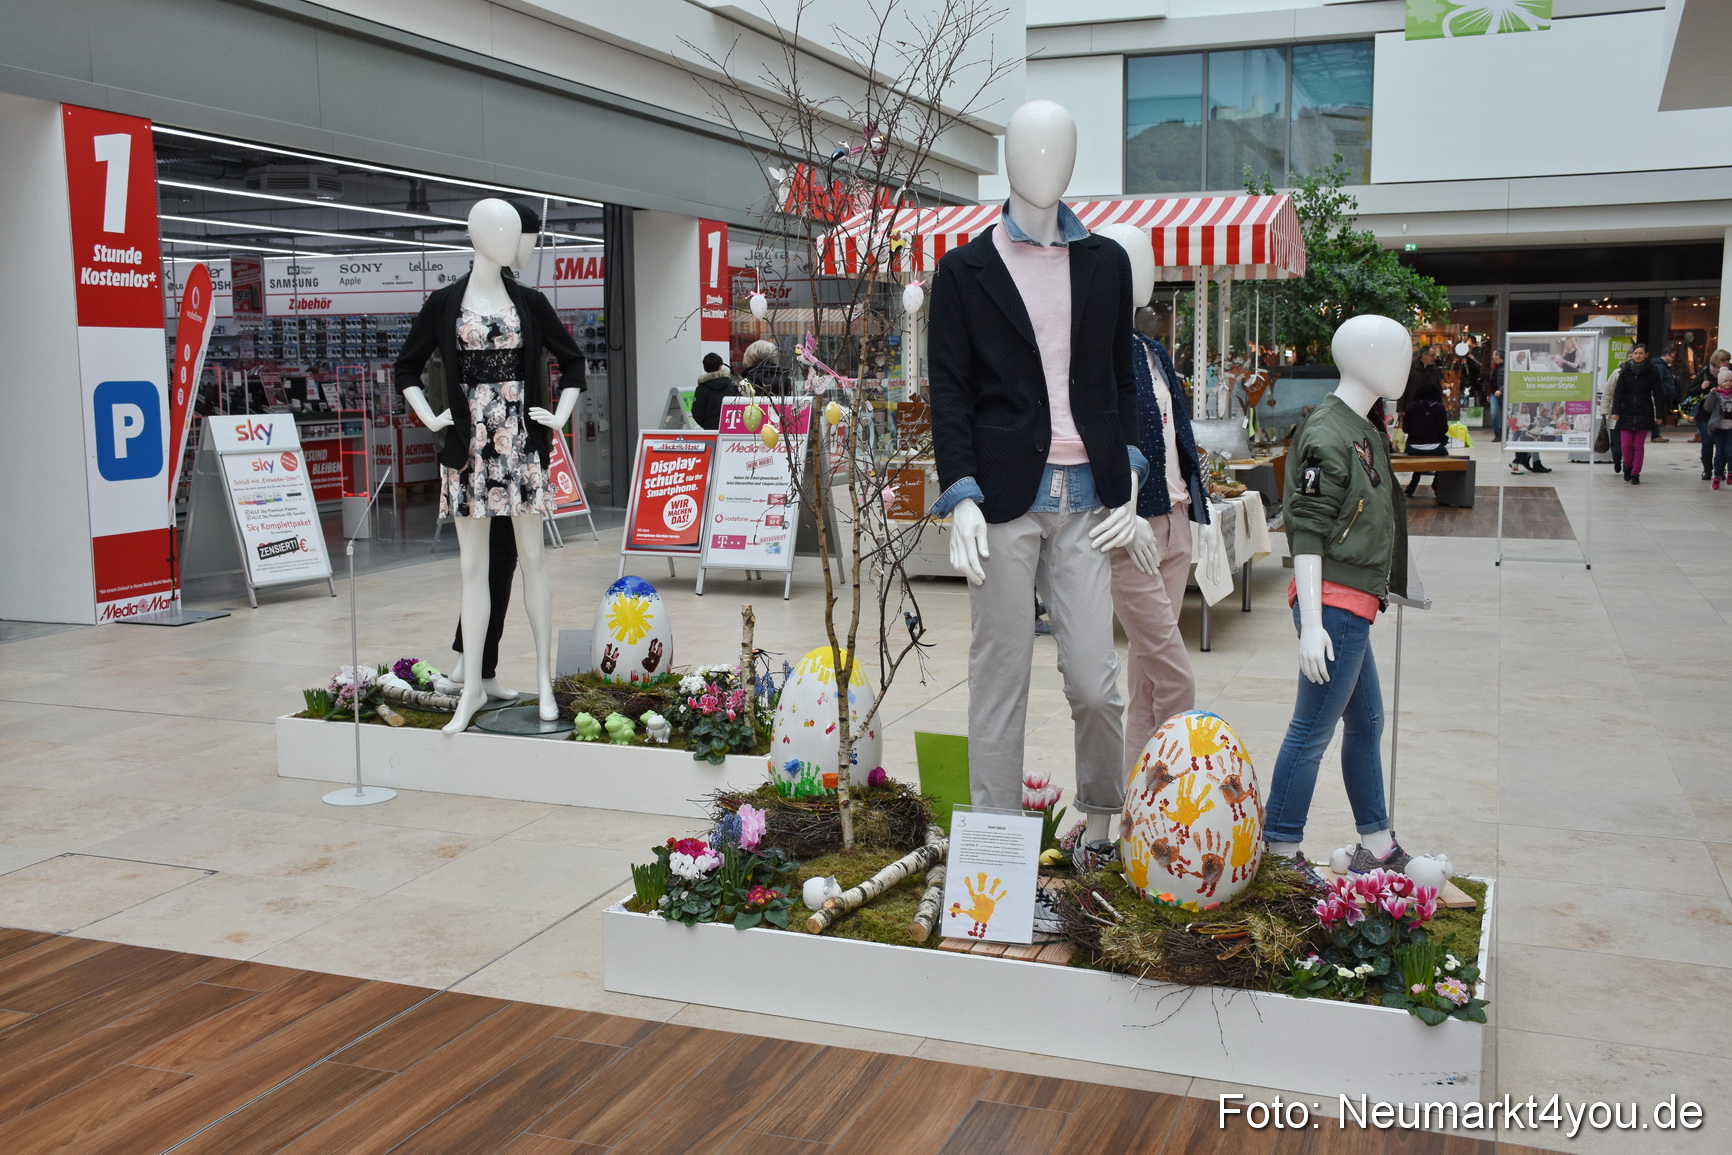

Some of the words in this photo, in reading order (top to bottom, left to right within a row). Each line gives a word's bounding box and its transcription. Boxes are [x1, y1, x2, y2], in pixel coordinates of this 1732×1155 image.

[94, 133, 132, 234] 1
[93, 244, 142, 265] Stunde
[708, 231, 721, 288] 1
[340, 263, 383, 274] SONY
[270, 278, 319, 288] SAMSUNG
[340, 276, 362, 287] Apple
[288, 298, 332, 310] Zubehör
[706, 295, 723, 305] Stunde
[1612, 341, 1622, 351] DU
[1614, 352, 1627, 360] NOC
[1537, 376, 1578, 384] Lieblingsteil
[112, 402, 145, 459] P
[234, 418, 274, 446] sky
[725, 442, 760, 454] Media
[305, 449, 328, 462] ESUND
[252, 458, 274, 474] sky
[312, 464, 342, 475] BLEIBEN
[650, 457, 702, 474] Display-
[644, 472, 686, 490] schutz
[1304, 470, 1316, 494] 2
[646, 484, 698, 498] Smartphone.
[671, 499, 690, 510] WIR
[668, 508, 692, 517] MACHEN
[246, 524, 260, 533] Sky
[260, 518, 312, 530] Komplettpaket
[671, 515, 690, 524] DAS!
[260, 540, 298, 558] ZENSIERT!
[100, 603, 138, 621] Media
[958, 815, 966, 828] 3
